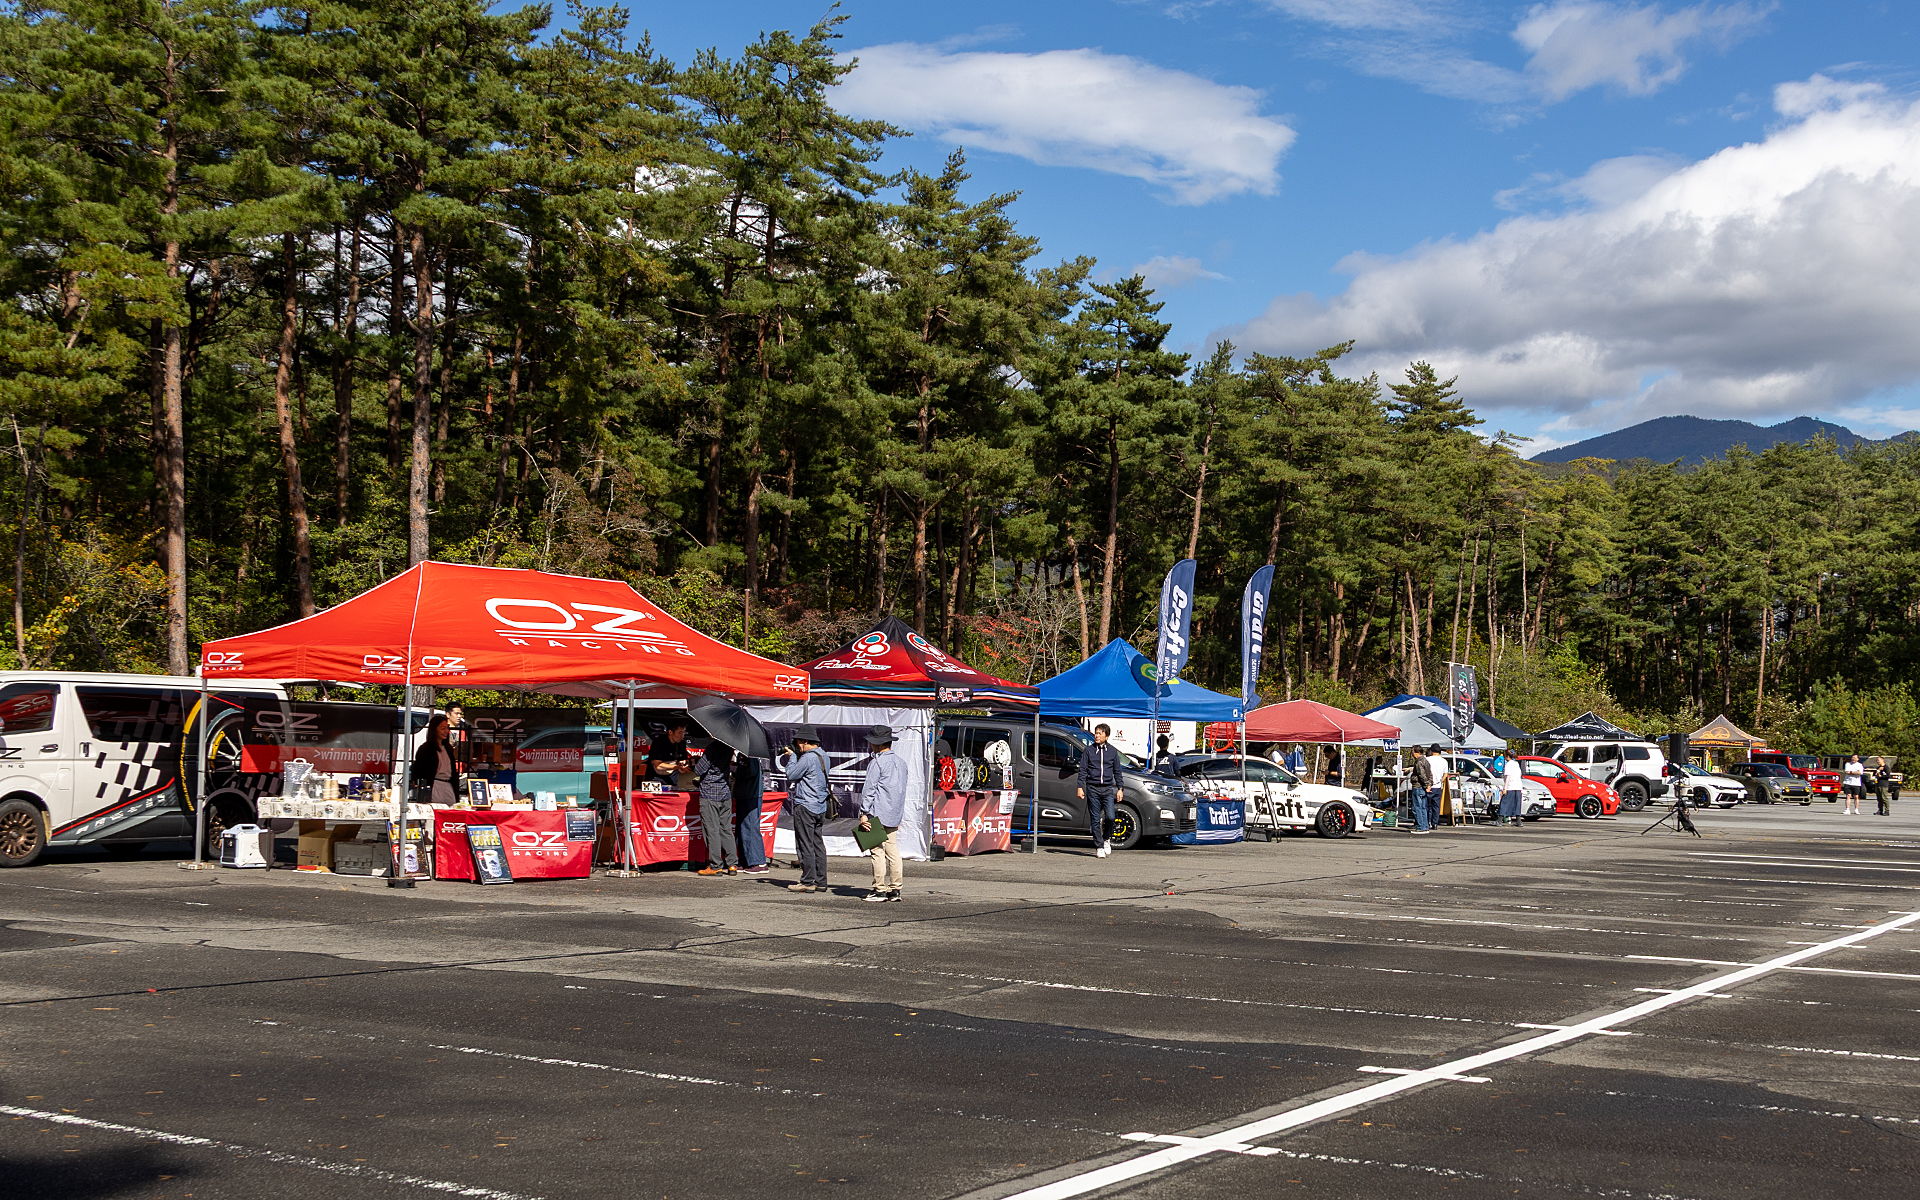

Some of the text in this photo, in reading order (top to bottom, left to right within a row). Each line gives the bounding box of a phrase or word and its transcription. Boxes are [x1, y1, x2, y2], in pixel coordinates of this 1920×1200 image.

[1166, 584, 1188, 656] Craft
[507, 638, 696, 656] RACING
[255, 733, 319, 741] RACING
[559, 749, 580, 763] style
[1208, 806, 1230, 826] Craft
[471, 835, 501, 847] COFFEE
